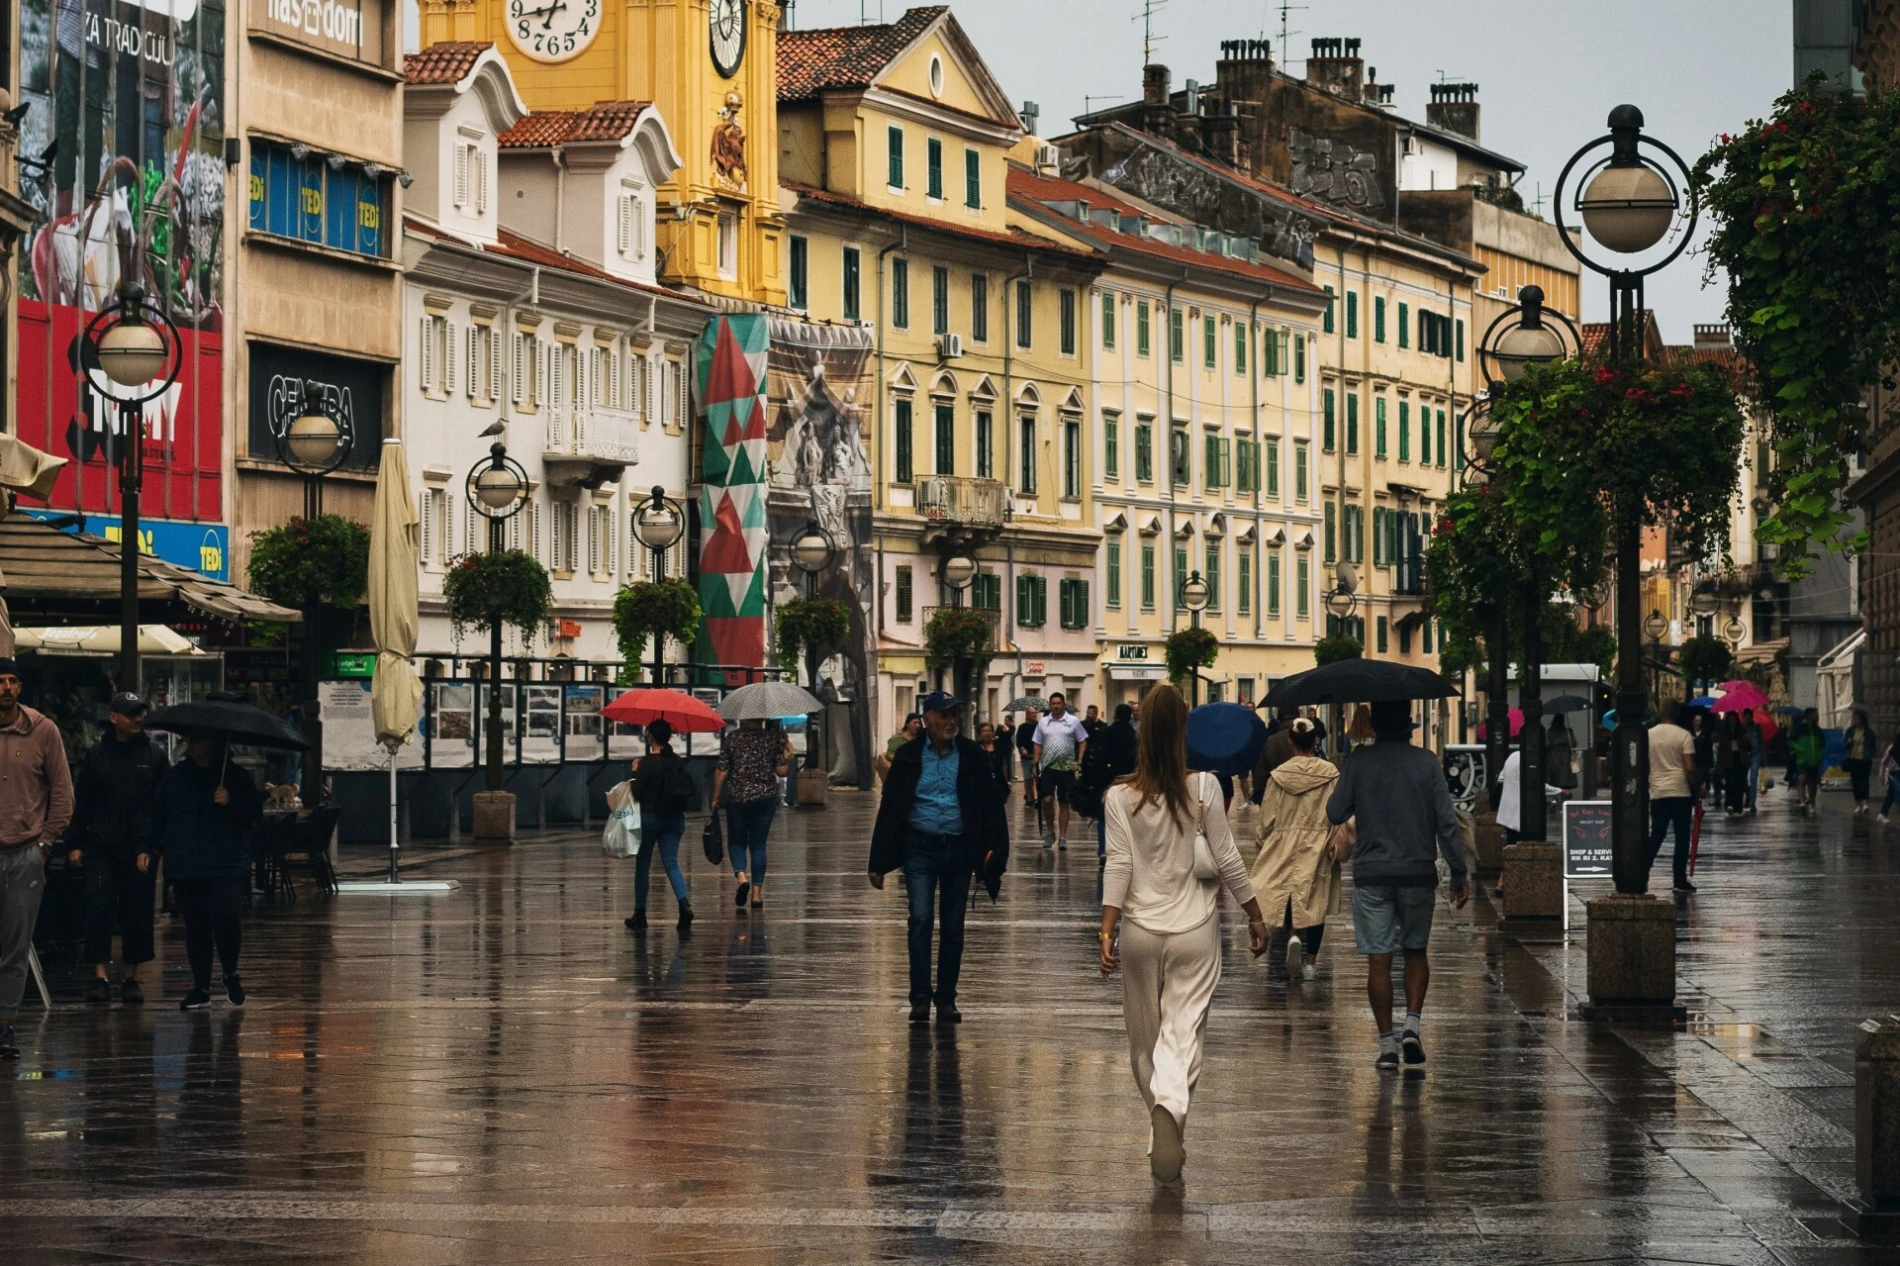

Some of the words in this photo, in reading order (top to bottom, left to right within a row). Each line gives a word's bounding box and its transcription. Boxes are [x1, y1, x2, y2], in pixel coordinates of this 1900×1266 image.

[323, 0, 363, 48] dom
[518, 19, 530, 39] 8
[577, 17, 589, 36] 4
[534, 33, 545, 51] 7
[547, 36, 559, 55] 6
[563, 31, 576, 51] 5
[359, 201, 379, 229] TEDi
[200, 546, 222, 571] TEDi
